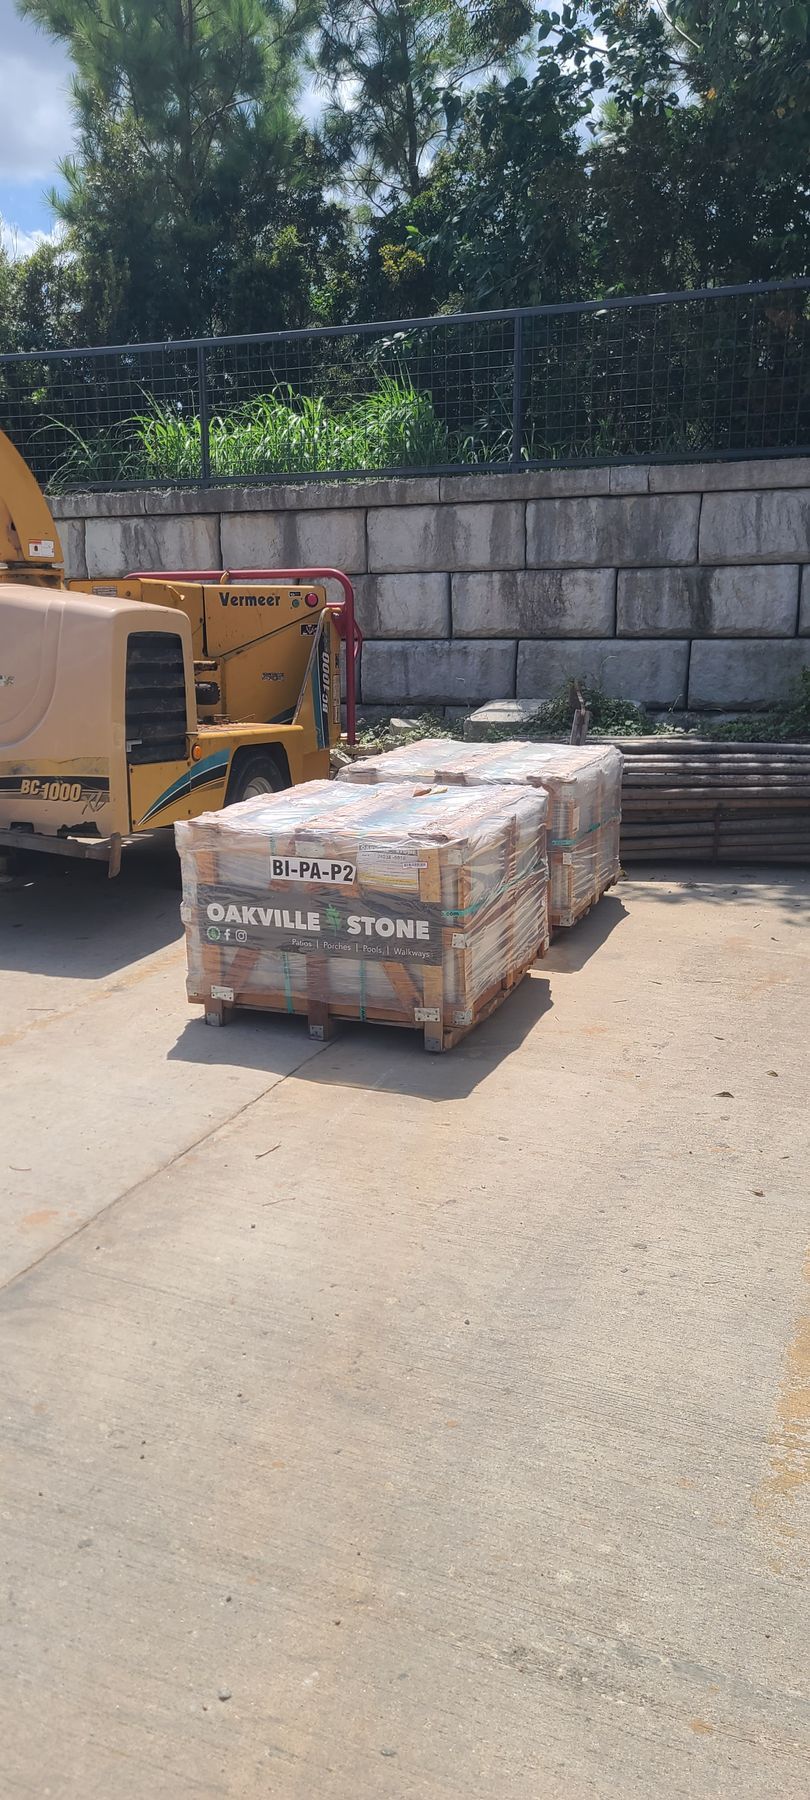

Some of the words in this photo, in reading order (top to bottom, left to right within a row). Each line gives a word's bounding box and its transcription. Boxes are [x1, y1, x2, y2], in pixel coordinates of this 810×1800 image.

[219, 592, 281, 607] Vermeer
[272, 859, 354, 882] BI-PA-P2
[206, 902, 321, 932] OAKVILLE
[346, 915, 430, 941] STONE
[291, 938, 313, 948] Patios
[323, 941, 352, 952] Porches
[393, 947, 431, 959] Walkways
